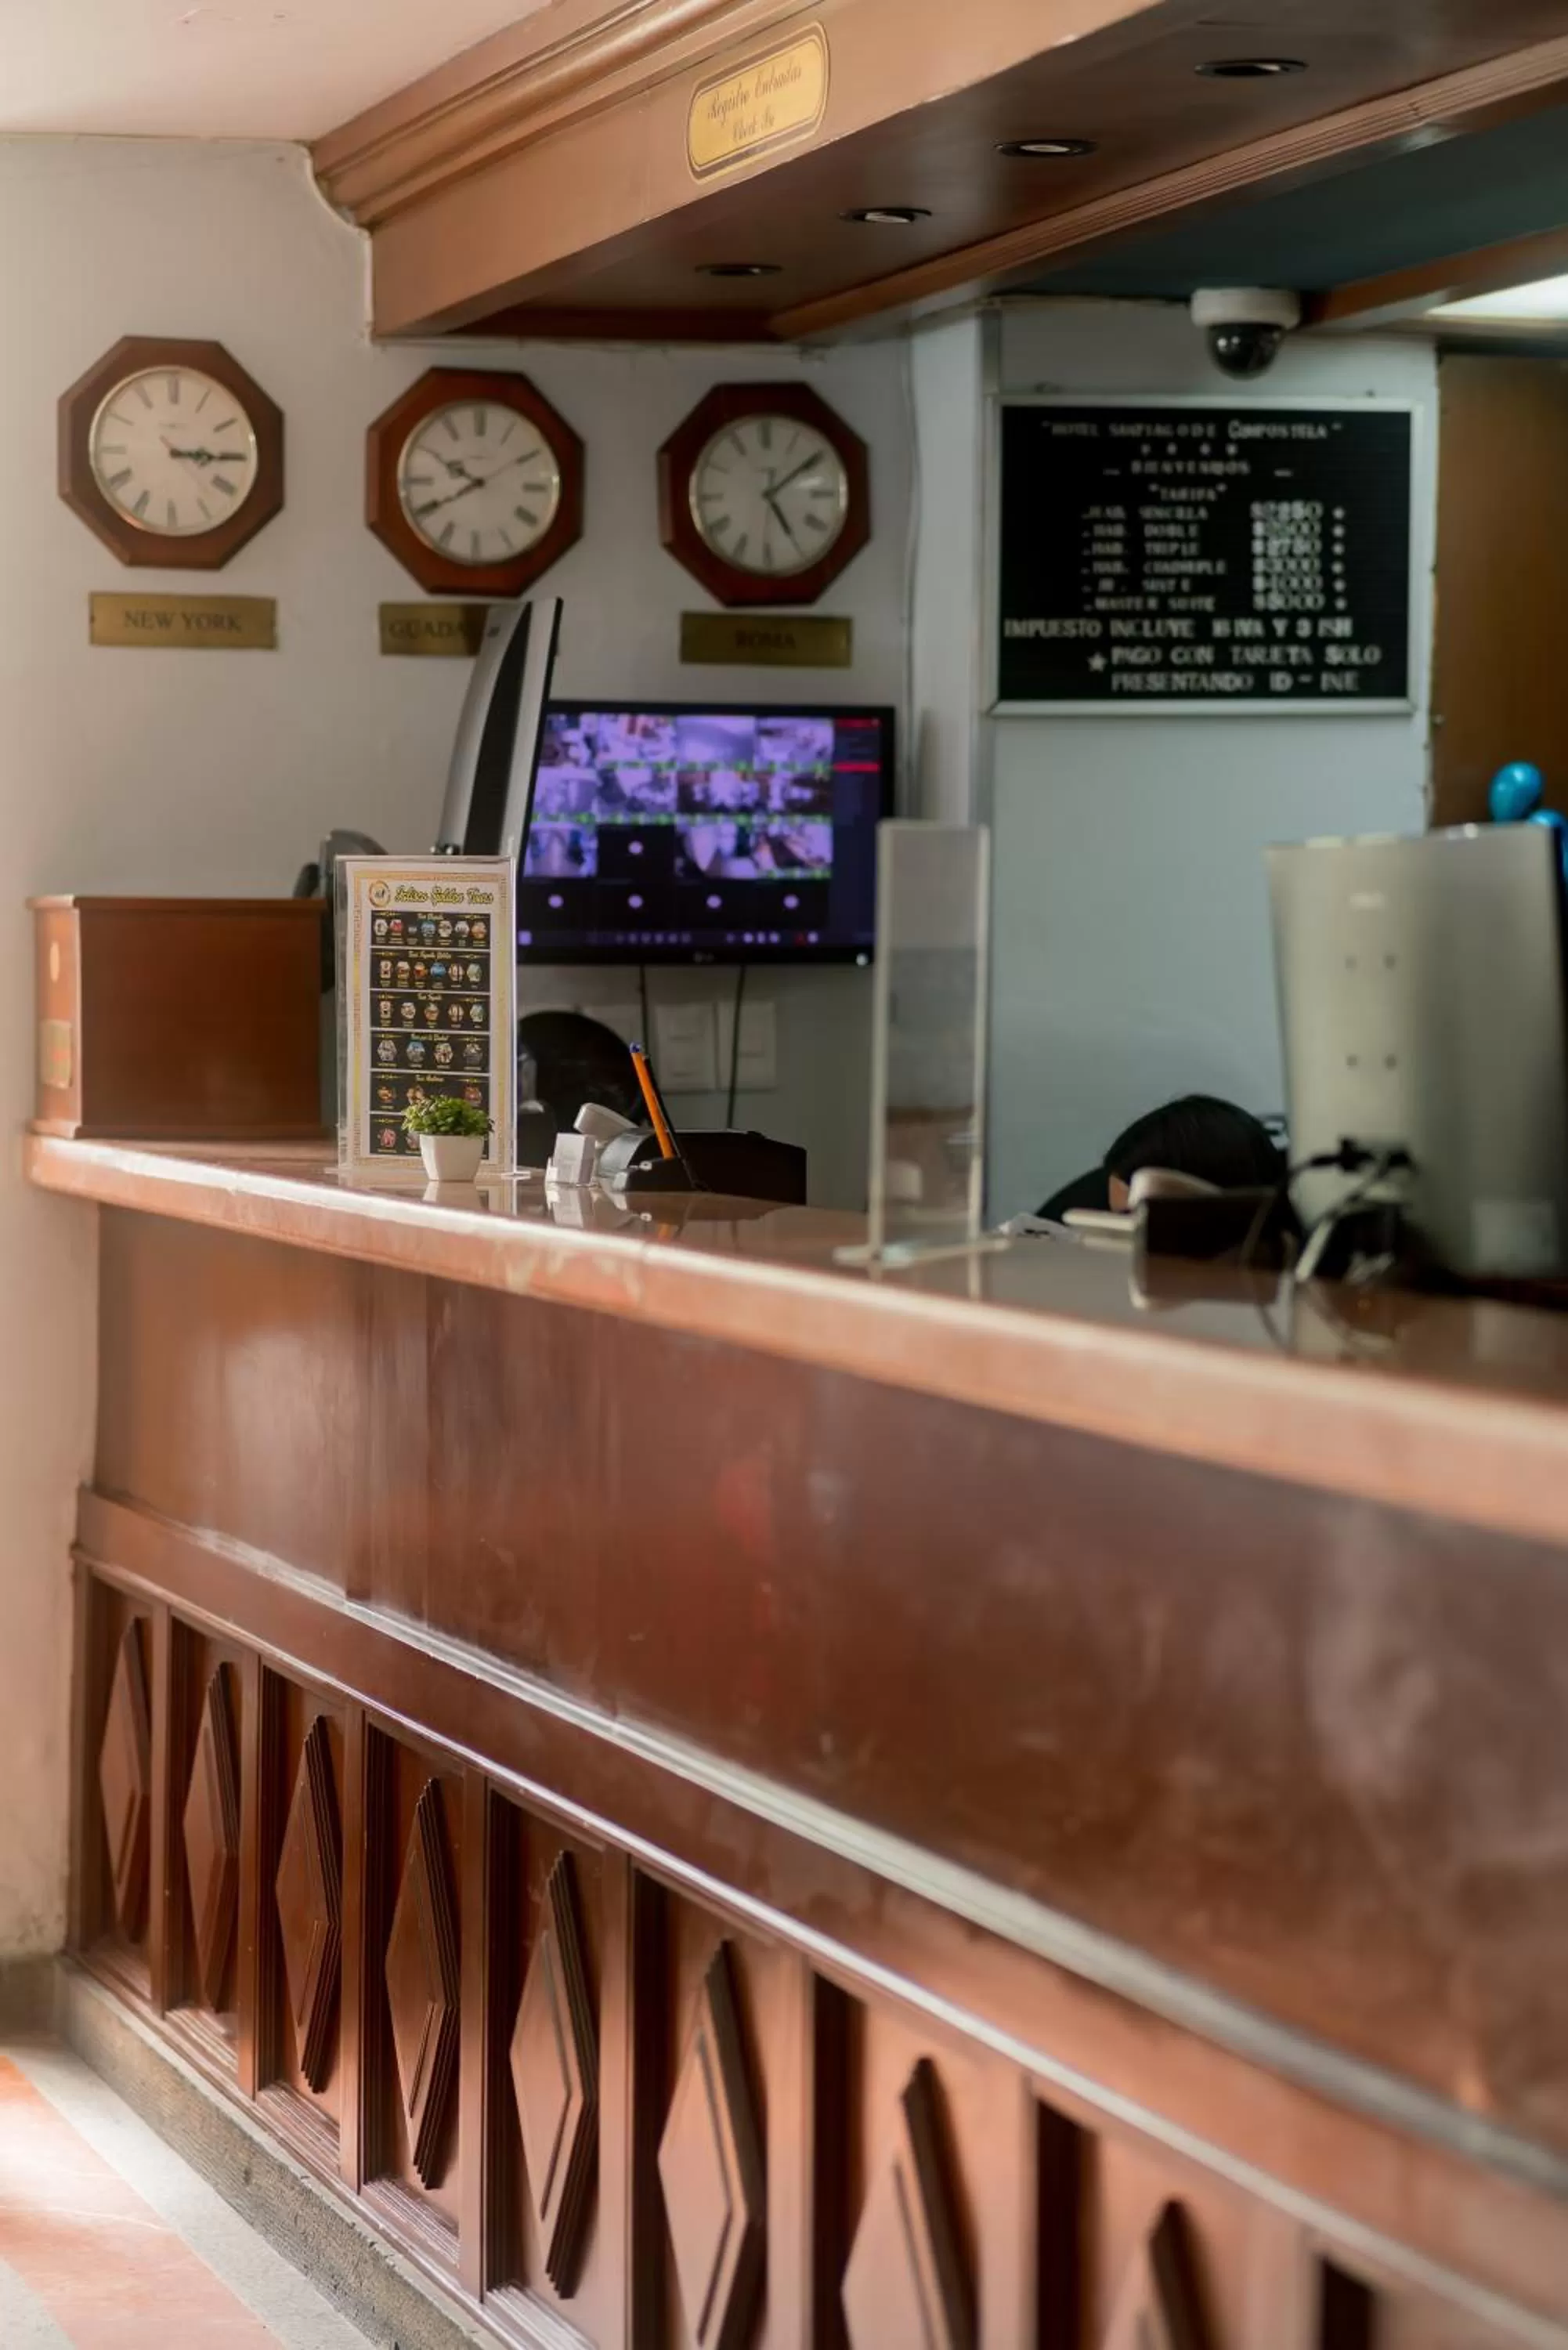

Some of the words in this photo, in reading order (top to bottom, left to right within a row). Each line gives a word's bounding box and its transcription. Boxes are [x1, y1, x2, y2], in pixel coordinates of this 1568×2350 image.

[124, 609, 174, 630] NEW
[181, 611, 242, 633] YORK
[1004, 617, 1103, 638] IMPUESTO
[1109, 618, 1195, 639] INCLUYE
[1271, 616, 1288, 638] Y
[1111, 645, 1163, 666] PAGO
[1169, 645, 1215, 666] CON
[1324, 644, 1382, 666] SOLO
[1111, 671, 1254, 692] PRESENTANDO
